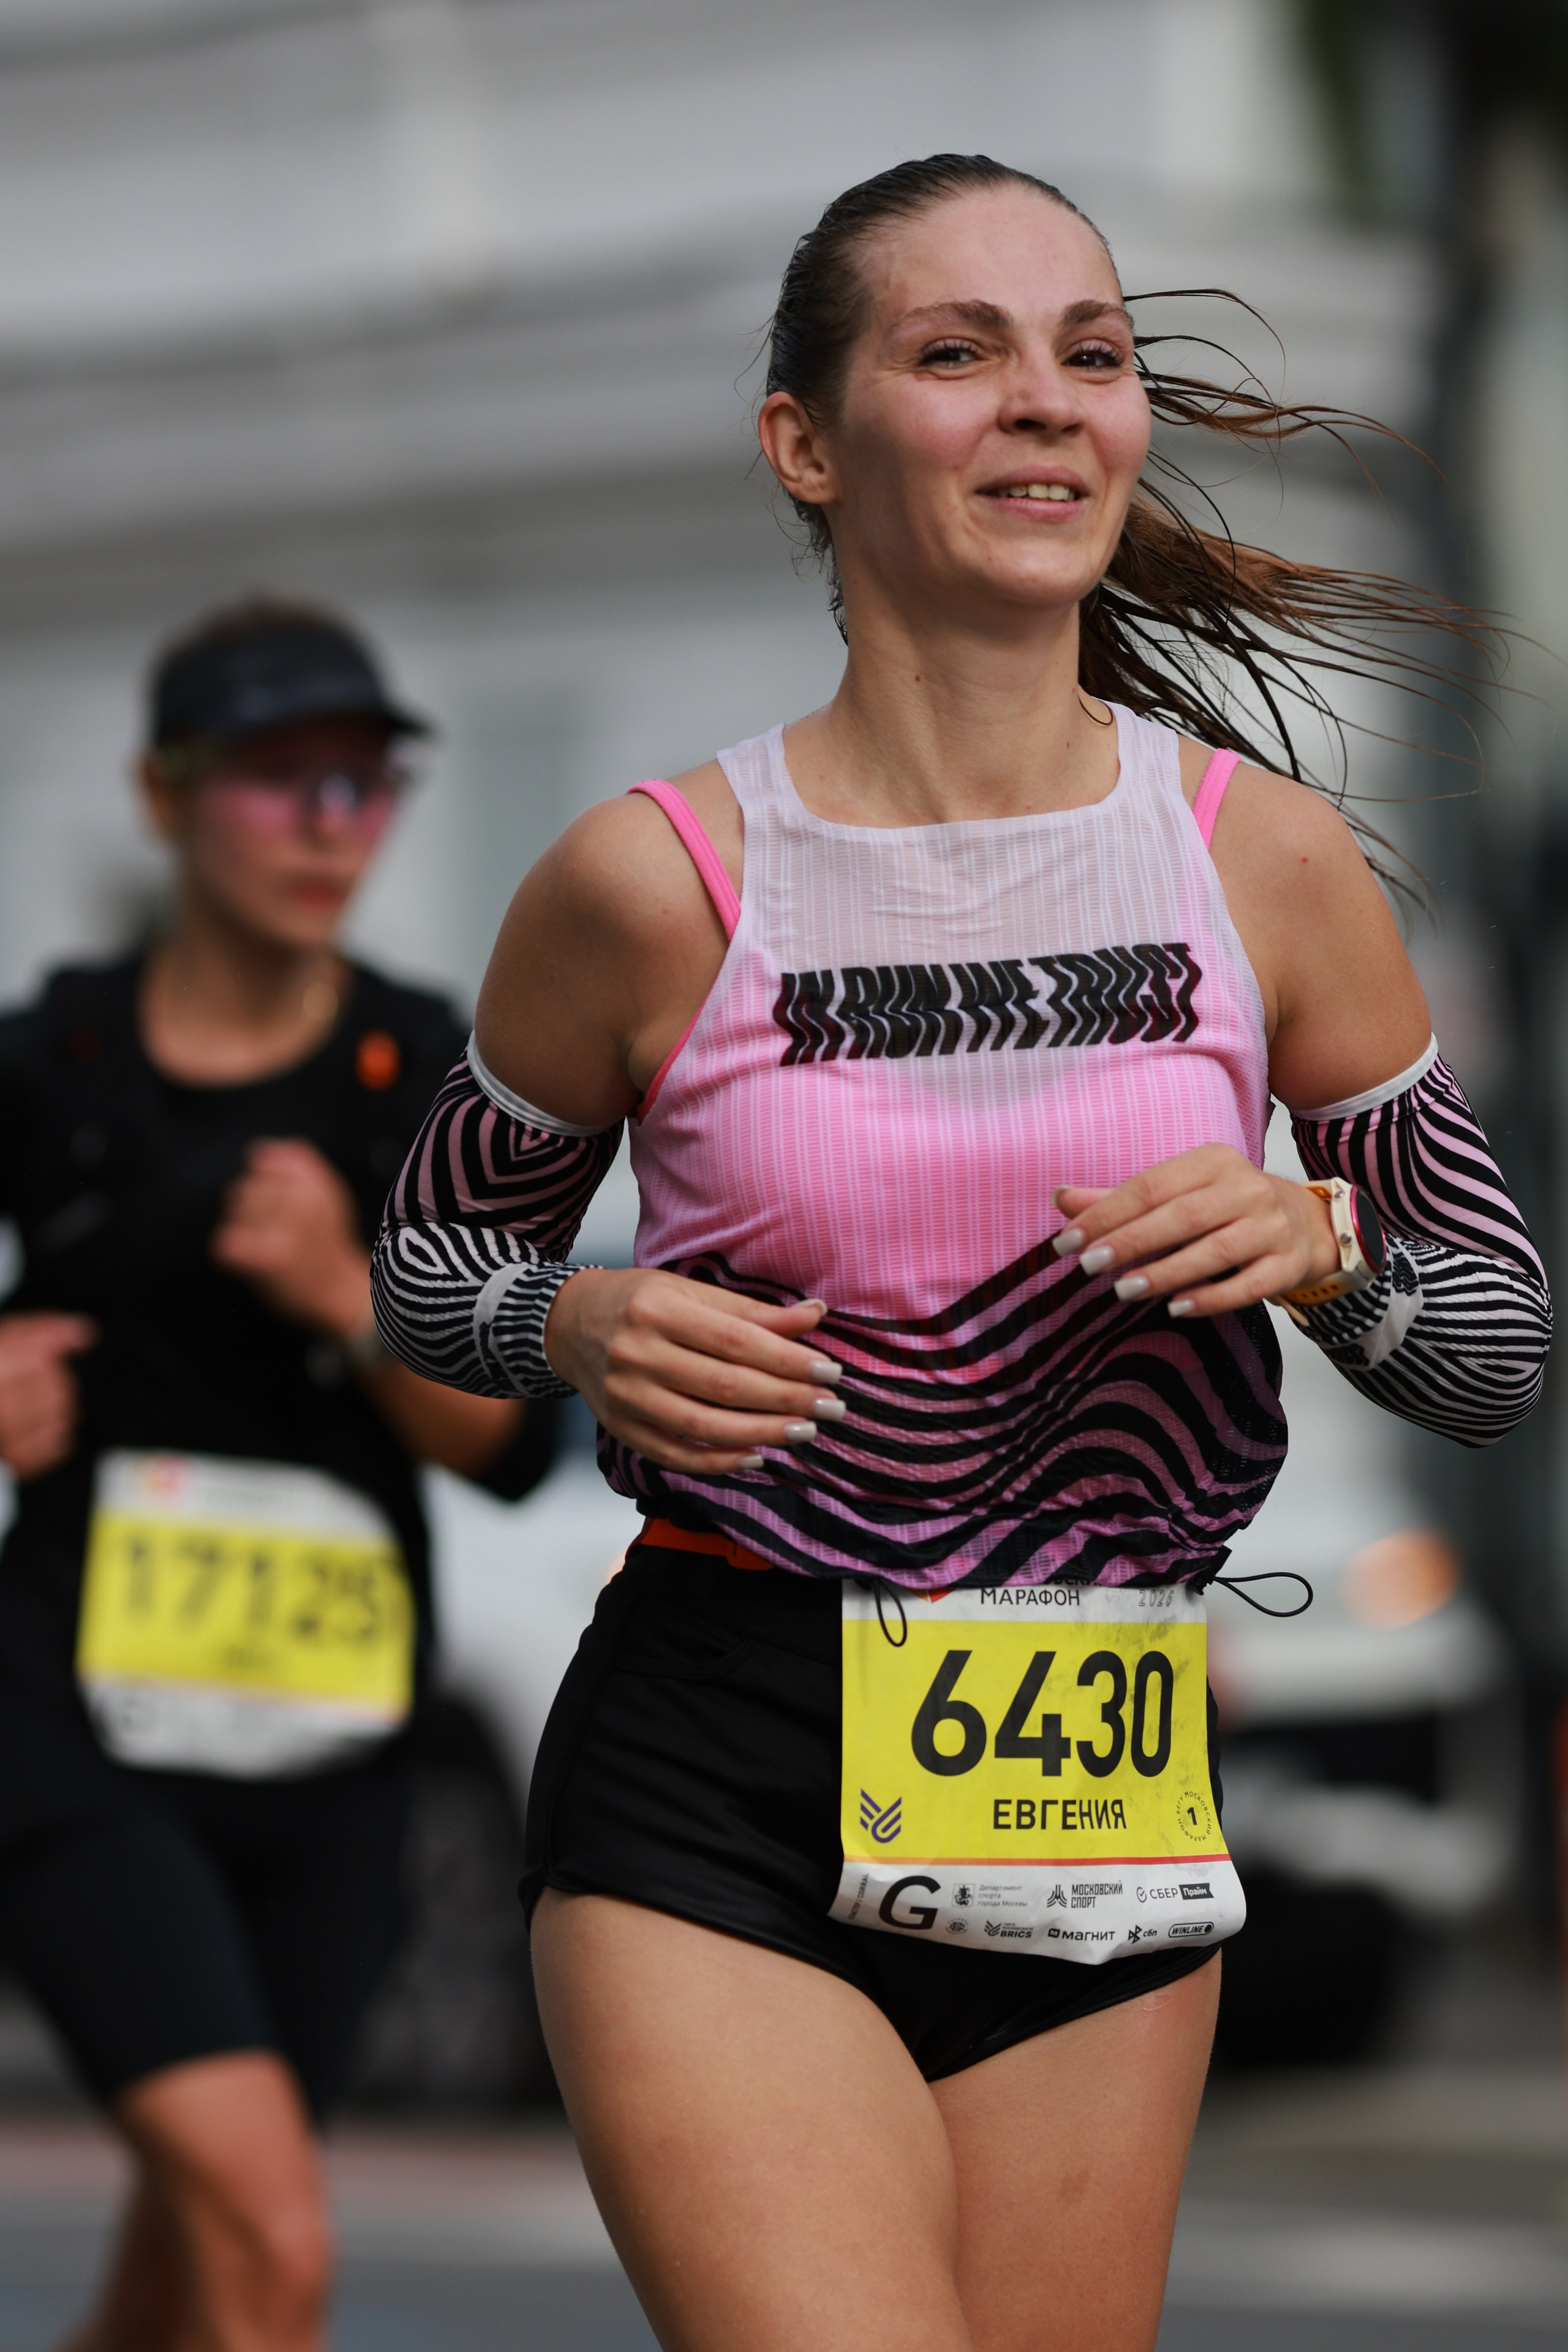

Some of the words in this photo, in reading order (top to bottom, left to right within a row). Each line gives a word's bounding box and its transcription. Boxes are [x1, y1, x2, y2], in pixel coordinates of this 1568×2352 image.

[773, 969, 846, 1068] IN
[835, 964, 964, 1058] RUN
[948, 959, 1050, 1053] WE
[1028, 943, 1202, 1049] TRUST
[980, 1589, 1080, 1606] МАРАФОН
[911, 1649, 1174, 1777] 6430
[992, 1798, 1127, 1830] ЕВГЕНИЯ
[1186, 1807, 1197, 1825] 1
[1071, 1880, 1123, 1896] МОСКОВСКИЙ
[1149, 1887, 1178, 1899] СБЕР
[1182, 1887, 1208, 1898] Прайм
[878, 1875, 941, 1930] G
[1071, 1896, 1096, 1908] СПОРТ
[1061, 1931, 1115, 1941] магнит
[1171, 1924, 1205, 1936] WINLINE
